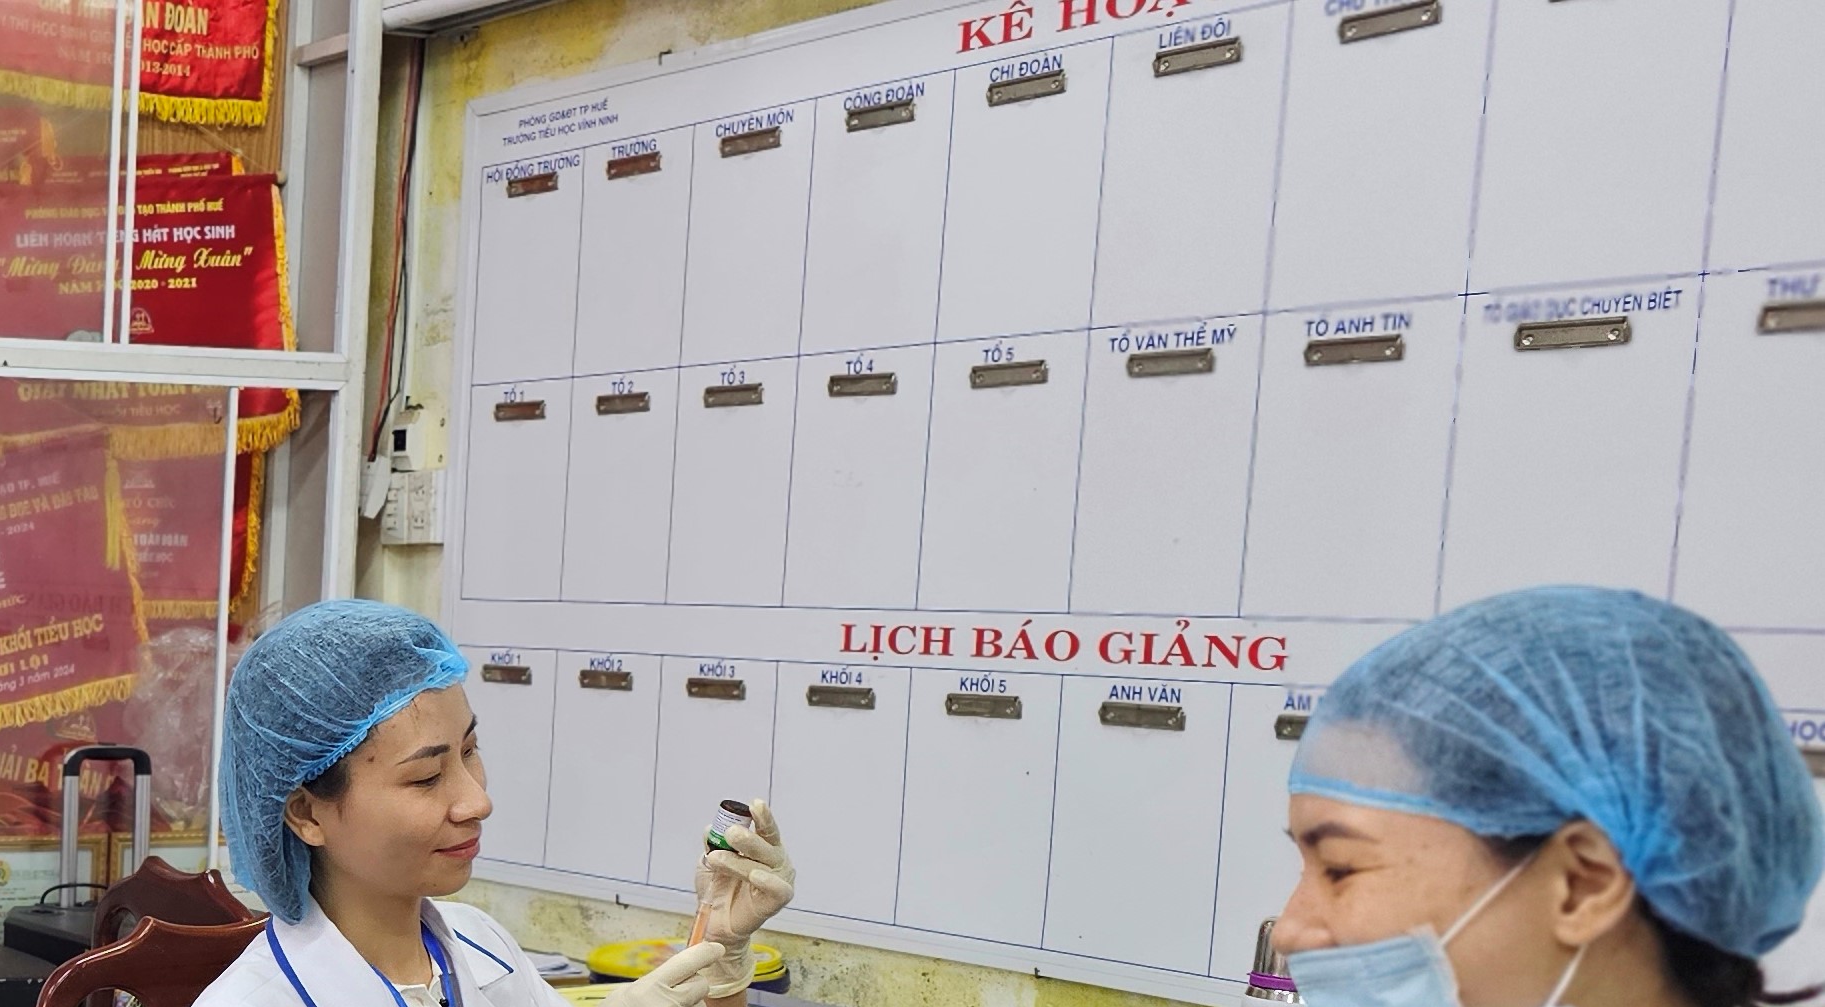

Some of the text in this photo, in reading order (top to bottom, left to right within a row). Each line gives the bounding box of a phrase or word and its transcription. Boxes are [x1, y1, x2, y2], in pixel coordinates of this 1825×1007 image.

[989, 65, 1016, 83] CHI
[173, 226, 201, 245] HỌC
[205, 225, 235, 240] SINH
[168, 277, 197, 289] 2021
[1334, 317, 1375, 335] ANH
[1006, 347, 1015, 361] 5
[866, 359, 874, 372] 4
[739, 371, 745, 384] 3
[840, 618, 1289, 671] LỊCH BÁO GIẢNG
[728, 666, 736, 678] 3
[854, 671, 863, 686] 4
[997, 679, 1007, 693] 5
[1109, 683, 1182, 703] ANH VĂN
